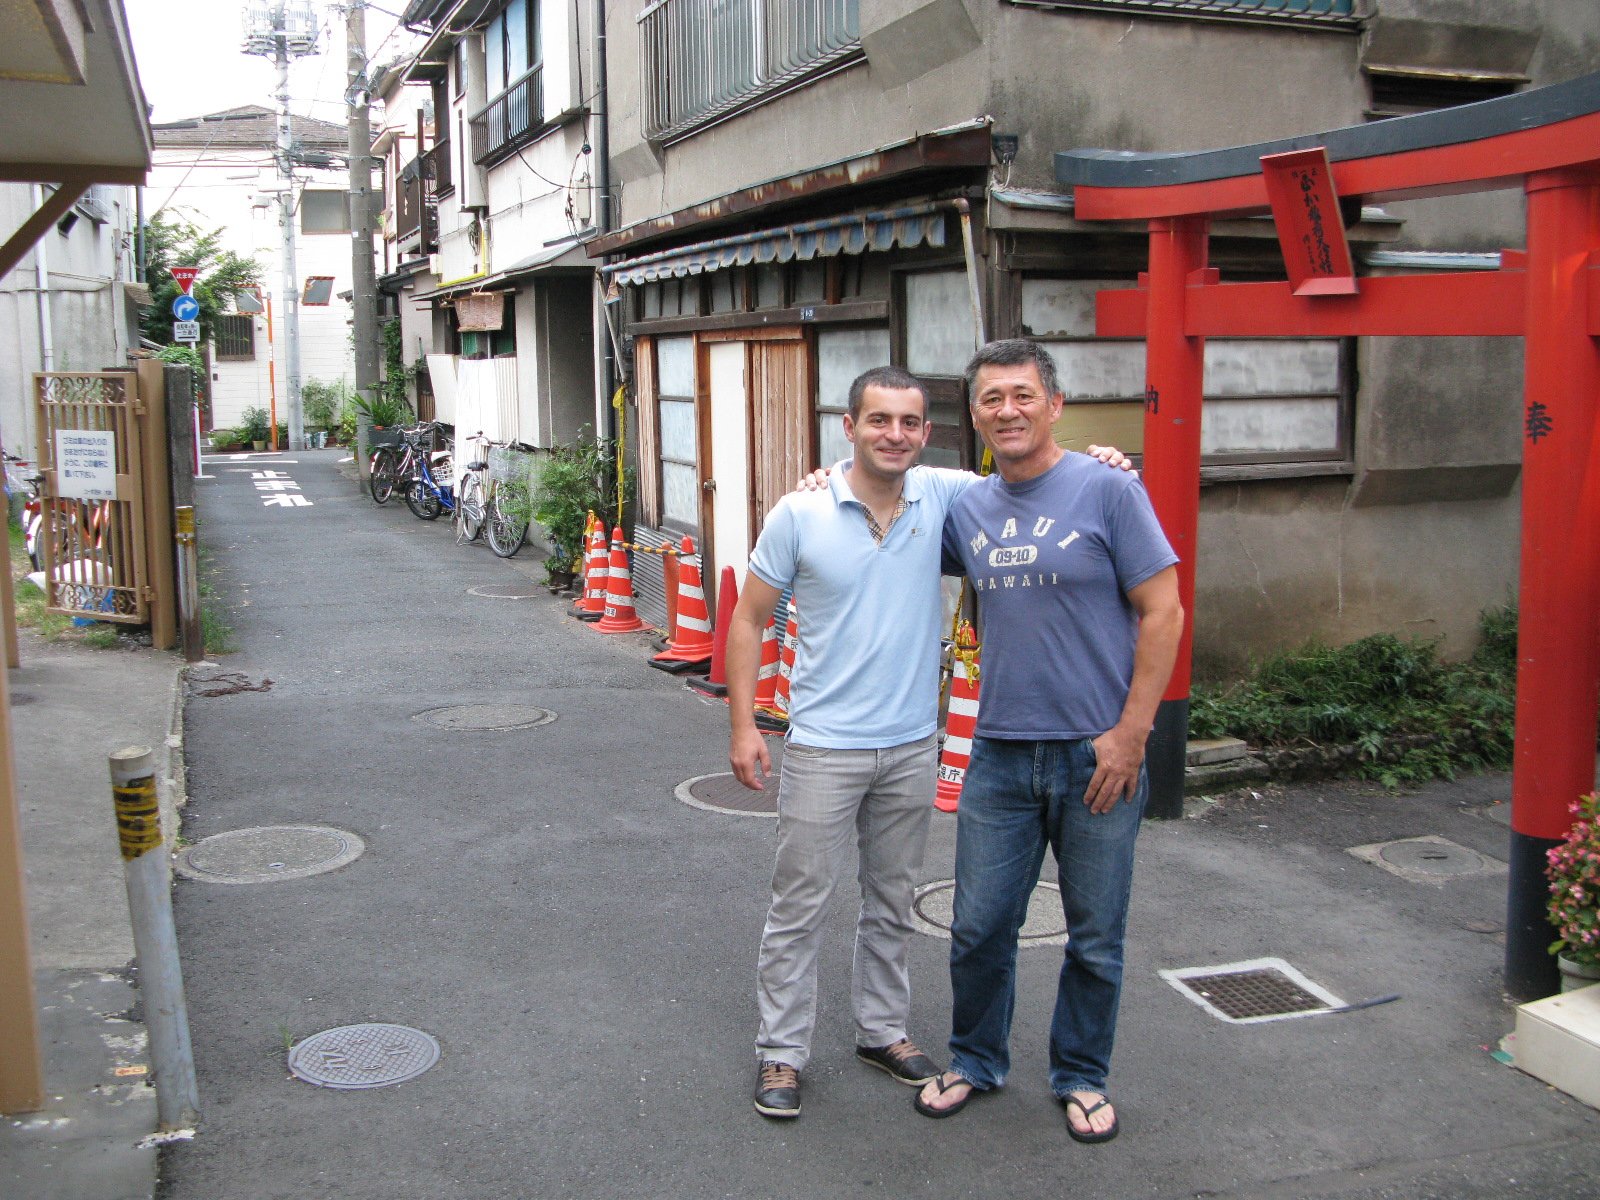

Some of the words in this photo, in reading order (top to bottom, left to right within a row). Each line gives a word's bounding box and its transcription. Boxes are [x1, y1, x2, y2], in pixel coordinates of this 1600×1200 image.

[1527, 401, 1553, 445] 奉
[250, 470, 314, 507] 止まれ
[970, 516, 1080, 556] MAUI
[996, 548, 1030, 564] 09-10
[978, 572, 1058, 591] HAWAII
